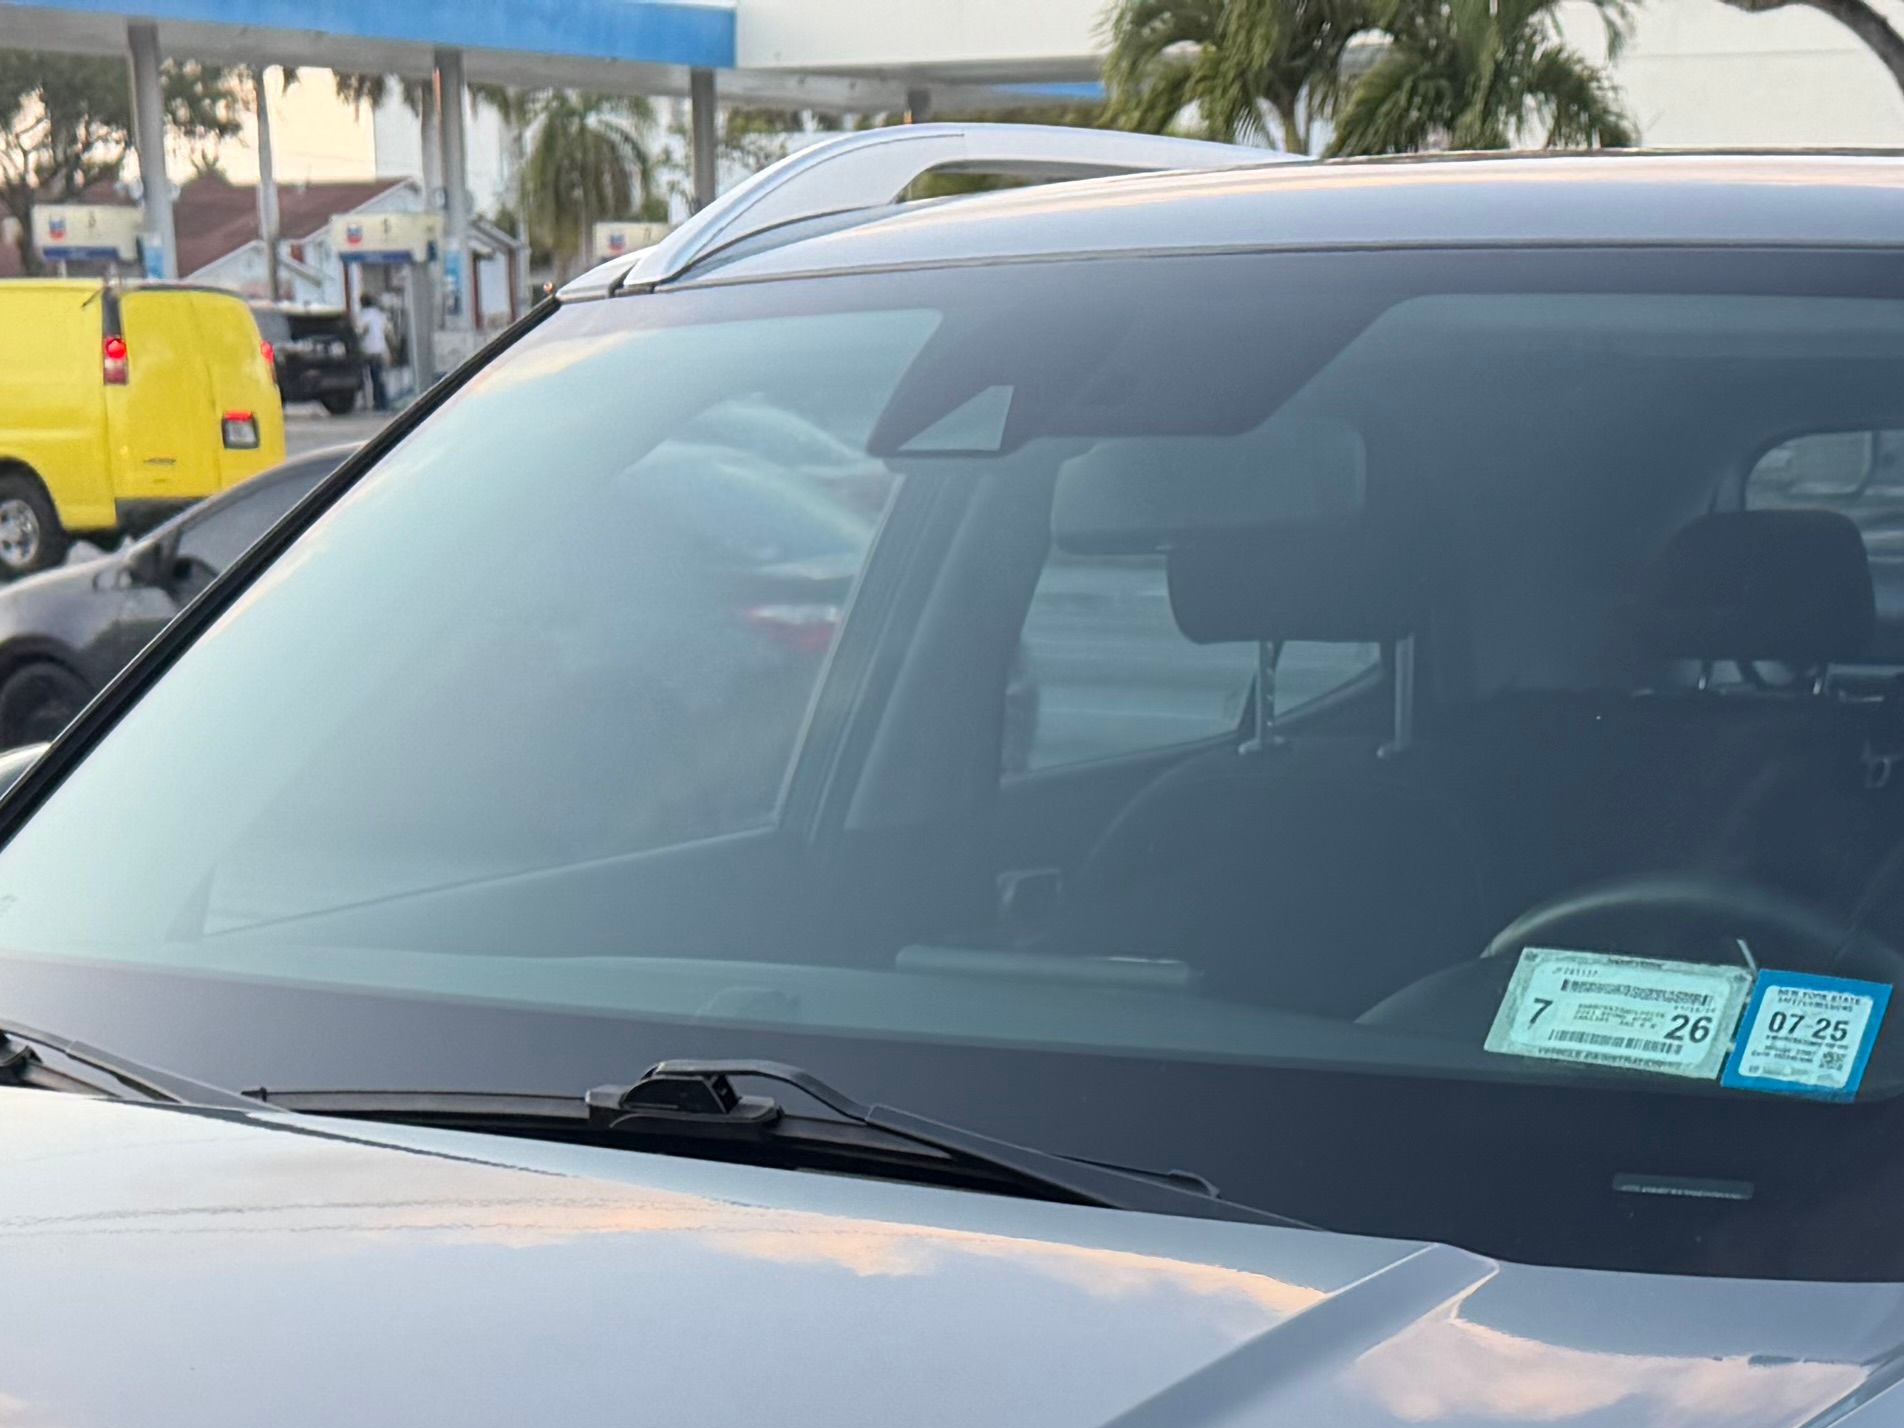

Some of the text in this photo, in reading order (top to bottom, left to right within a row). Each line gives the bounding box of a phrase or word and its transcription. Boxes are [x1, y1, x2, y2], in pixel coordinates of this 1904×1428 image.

[1527, 997, 1553, 1030] 7
[1663, 1014, 1713, 1043] 26
[1768, 1011, 1850, 1041] 07 25
